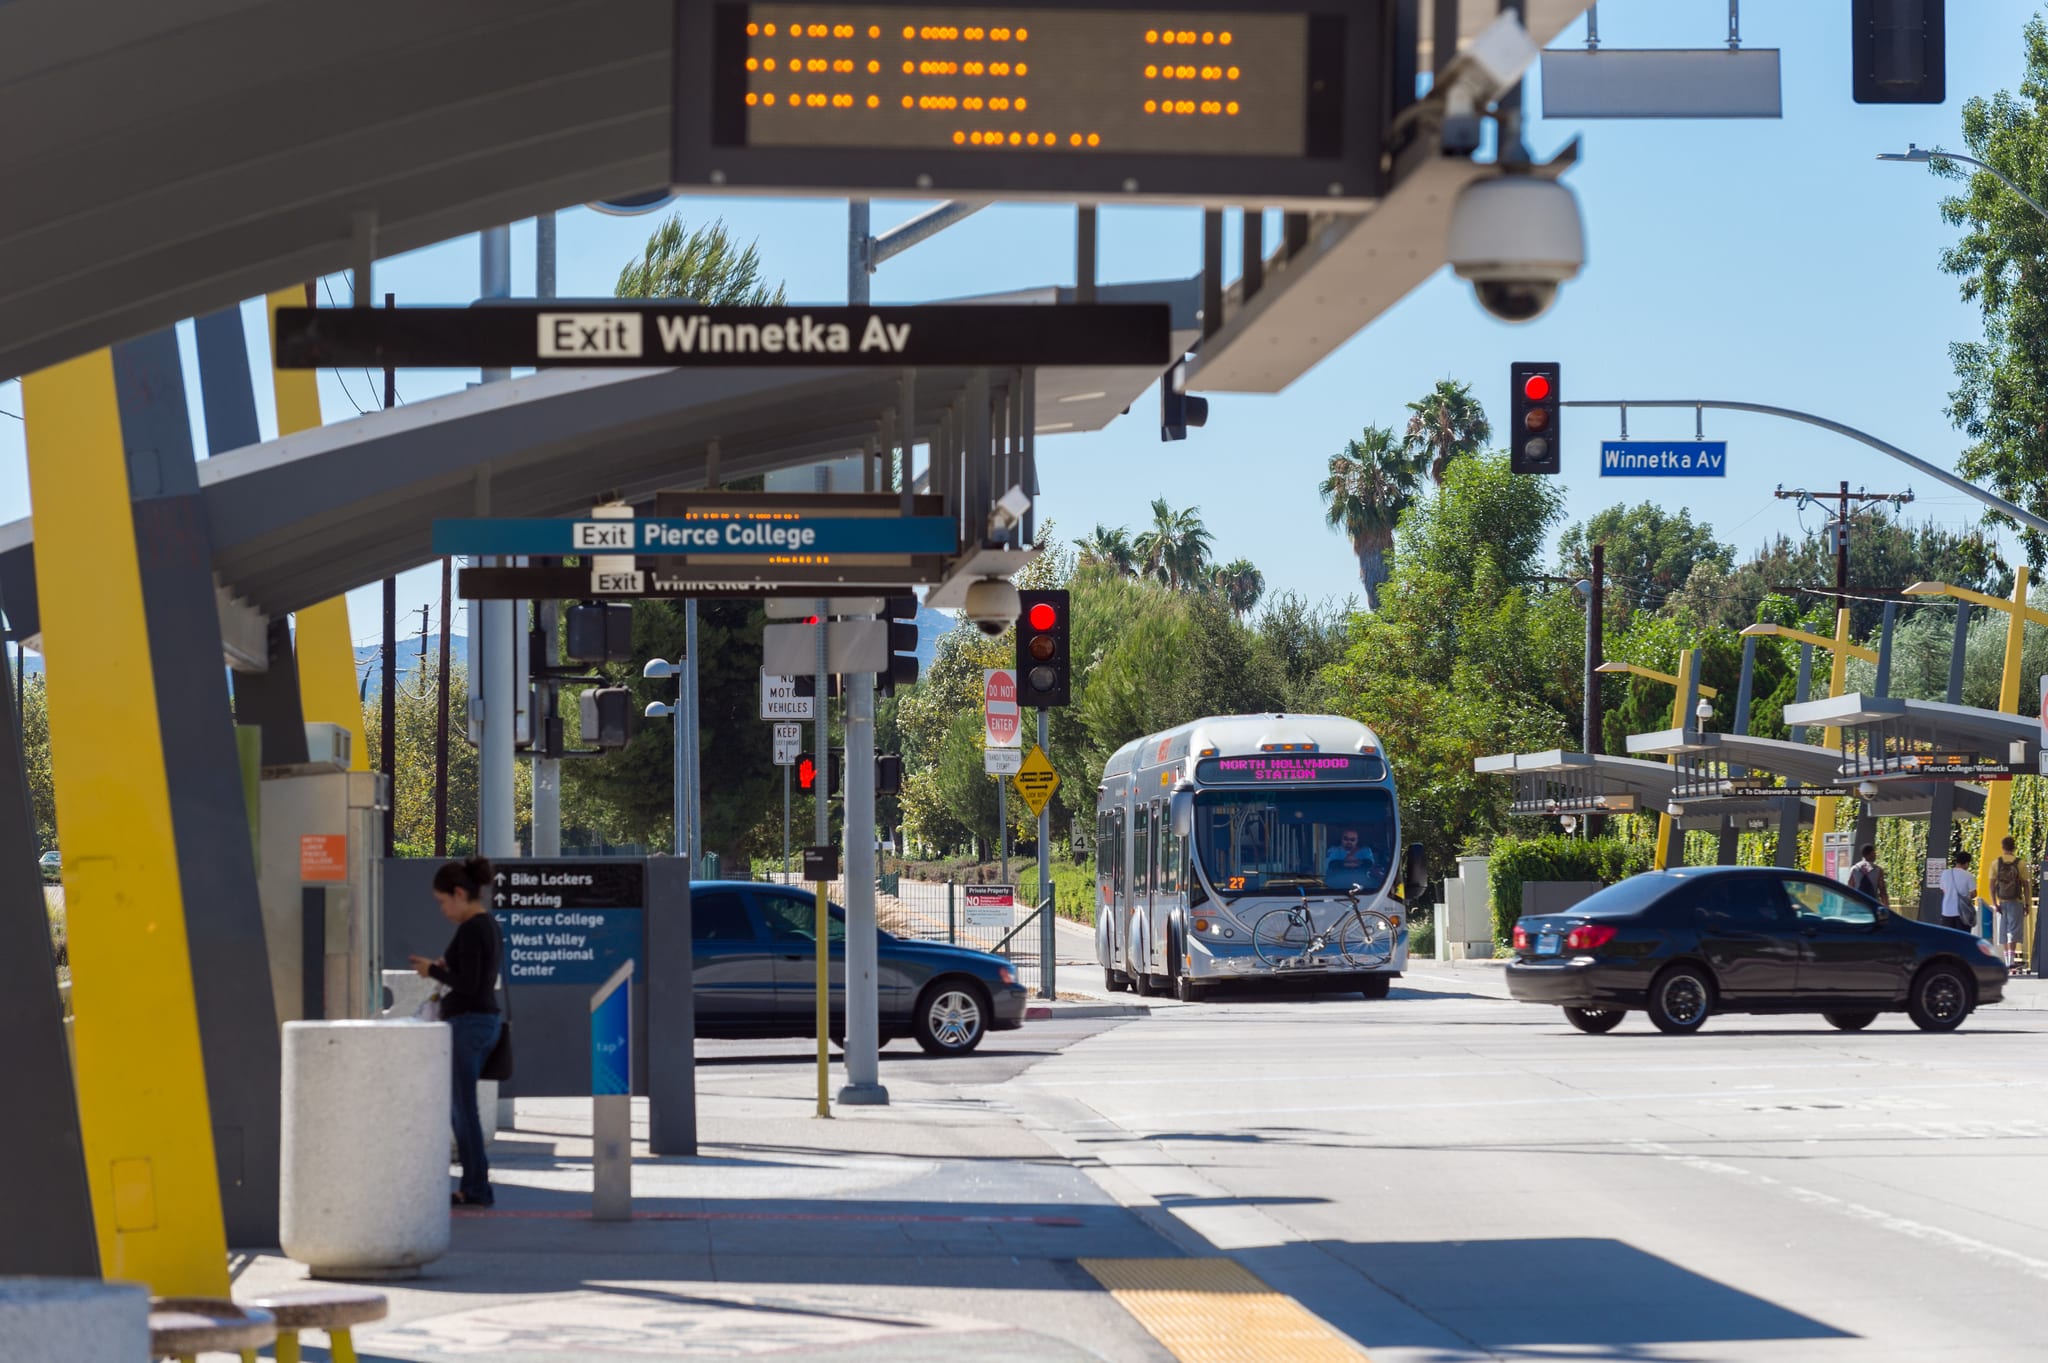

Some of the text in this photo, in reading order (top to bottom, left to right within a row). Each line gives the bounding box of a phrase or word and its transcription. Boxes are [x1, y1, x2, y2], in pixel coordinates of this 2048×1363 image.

[553, 315, 912, 353] Exit Winnetka Av
[1604, 450, 1722, 469] Winnetka Av
[582, 523, 816, 549] Exit Pierce College
[598, 574, 638, 591] Exit
[770, 688, 797, 697] MOTO
[989, 685, 1014, 698] DO NOT
[768, 702, 808, 712] VEHICLES
[991, 718, 1014, 731] ENTER
[777, 728, 797, 738] KEEP
[1219, 758, 1349, 770] NORTH HOLLYWOOD
[1923, 764, 1946, 772] Pierce
[1255, 769, 1316, 780] STATION
[1074, 836, 1085, 849] 4
[511, 873, 593, 886] Bike Lockers
[1228, 876, 1246, 889] 27
[511, 893, 562, 908] Parking
[966, 896, 980, 906] NO
[511, 913, 604, 928] Pierce College
[511, 934, 586, 947] West Valley
[511, 948, 594, 963] Occupational
[511, 964, 556, 976] Center
